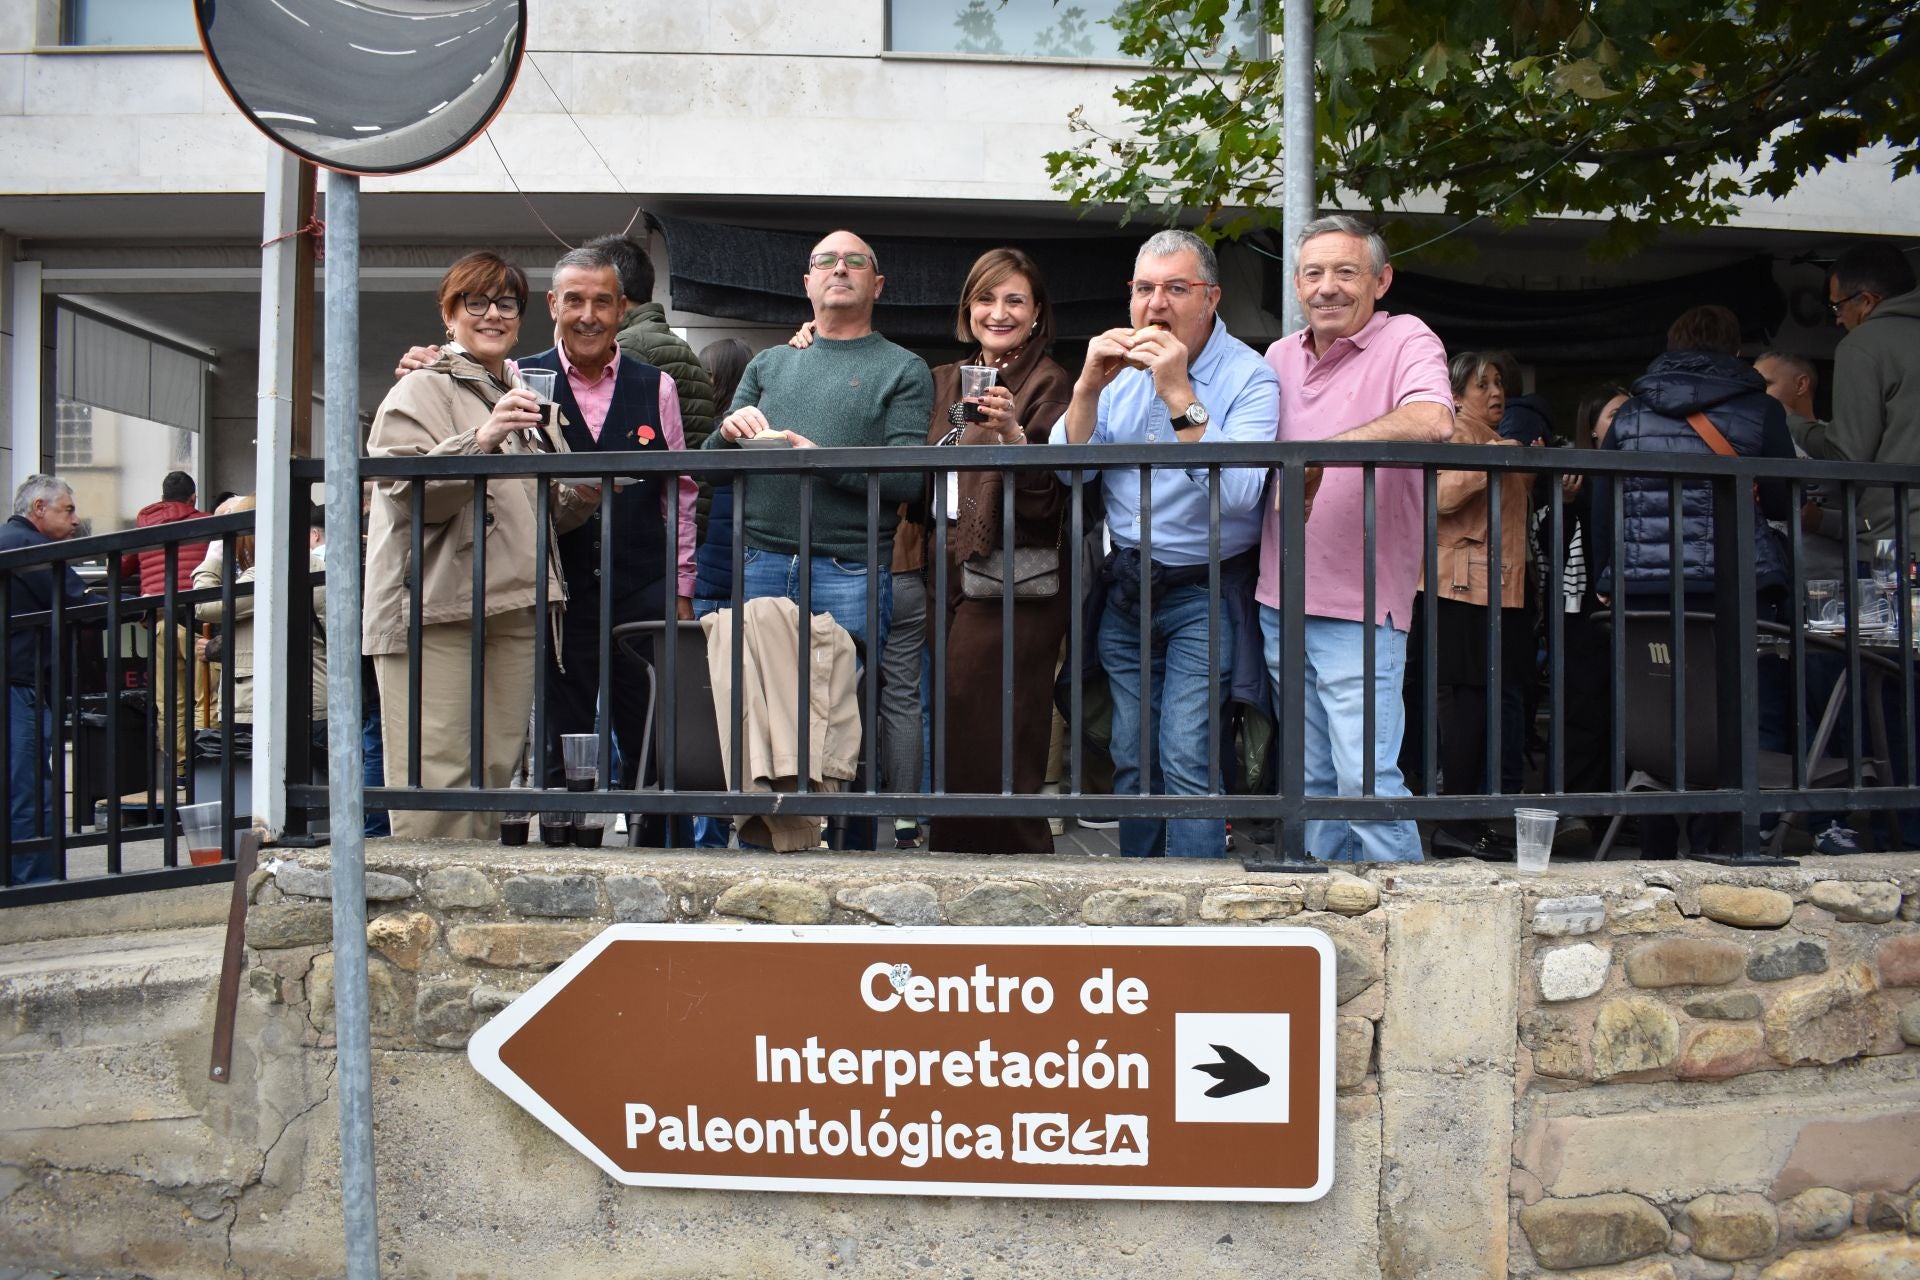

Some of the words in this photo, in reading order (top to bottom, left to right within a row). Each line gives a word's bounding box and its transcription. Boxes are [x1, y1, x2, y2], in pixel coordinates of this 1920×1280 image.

[860, 961, 1055, 1015] Centro
[1079, 967, 1149, 1015] de
[755, 1035, 1149, 1098] Interpretación
[625, 1102, 1005, 1168] Paleontológica
